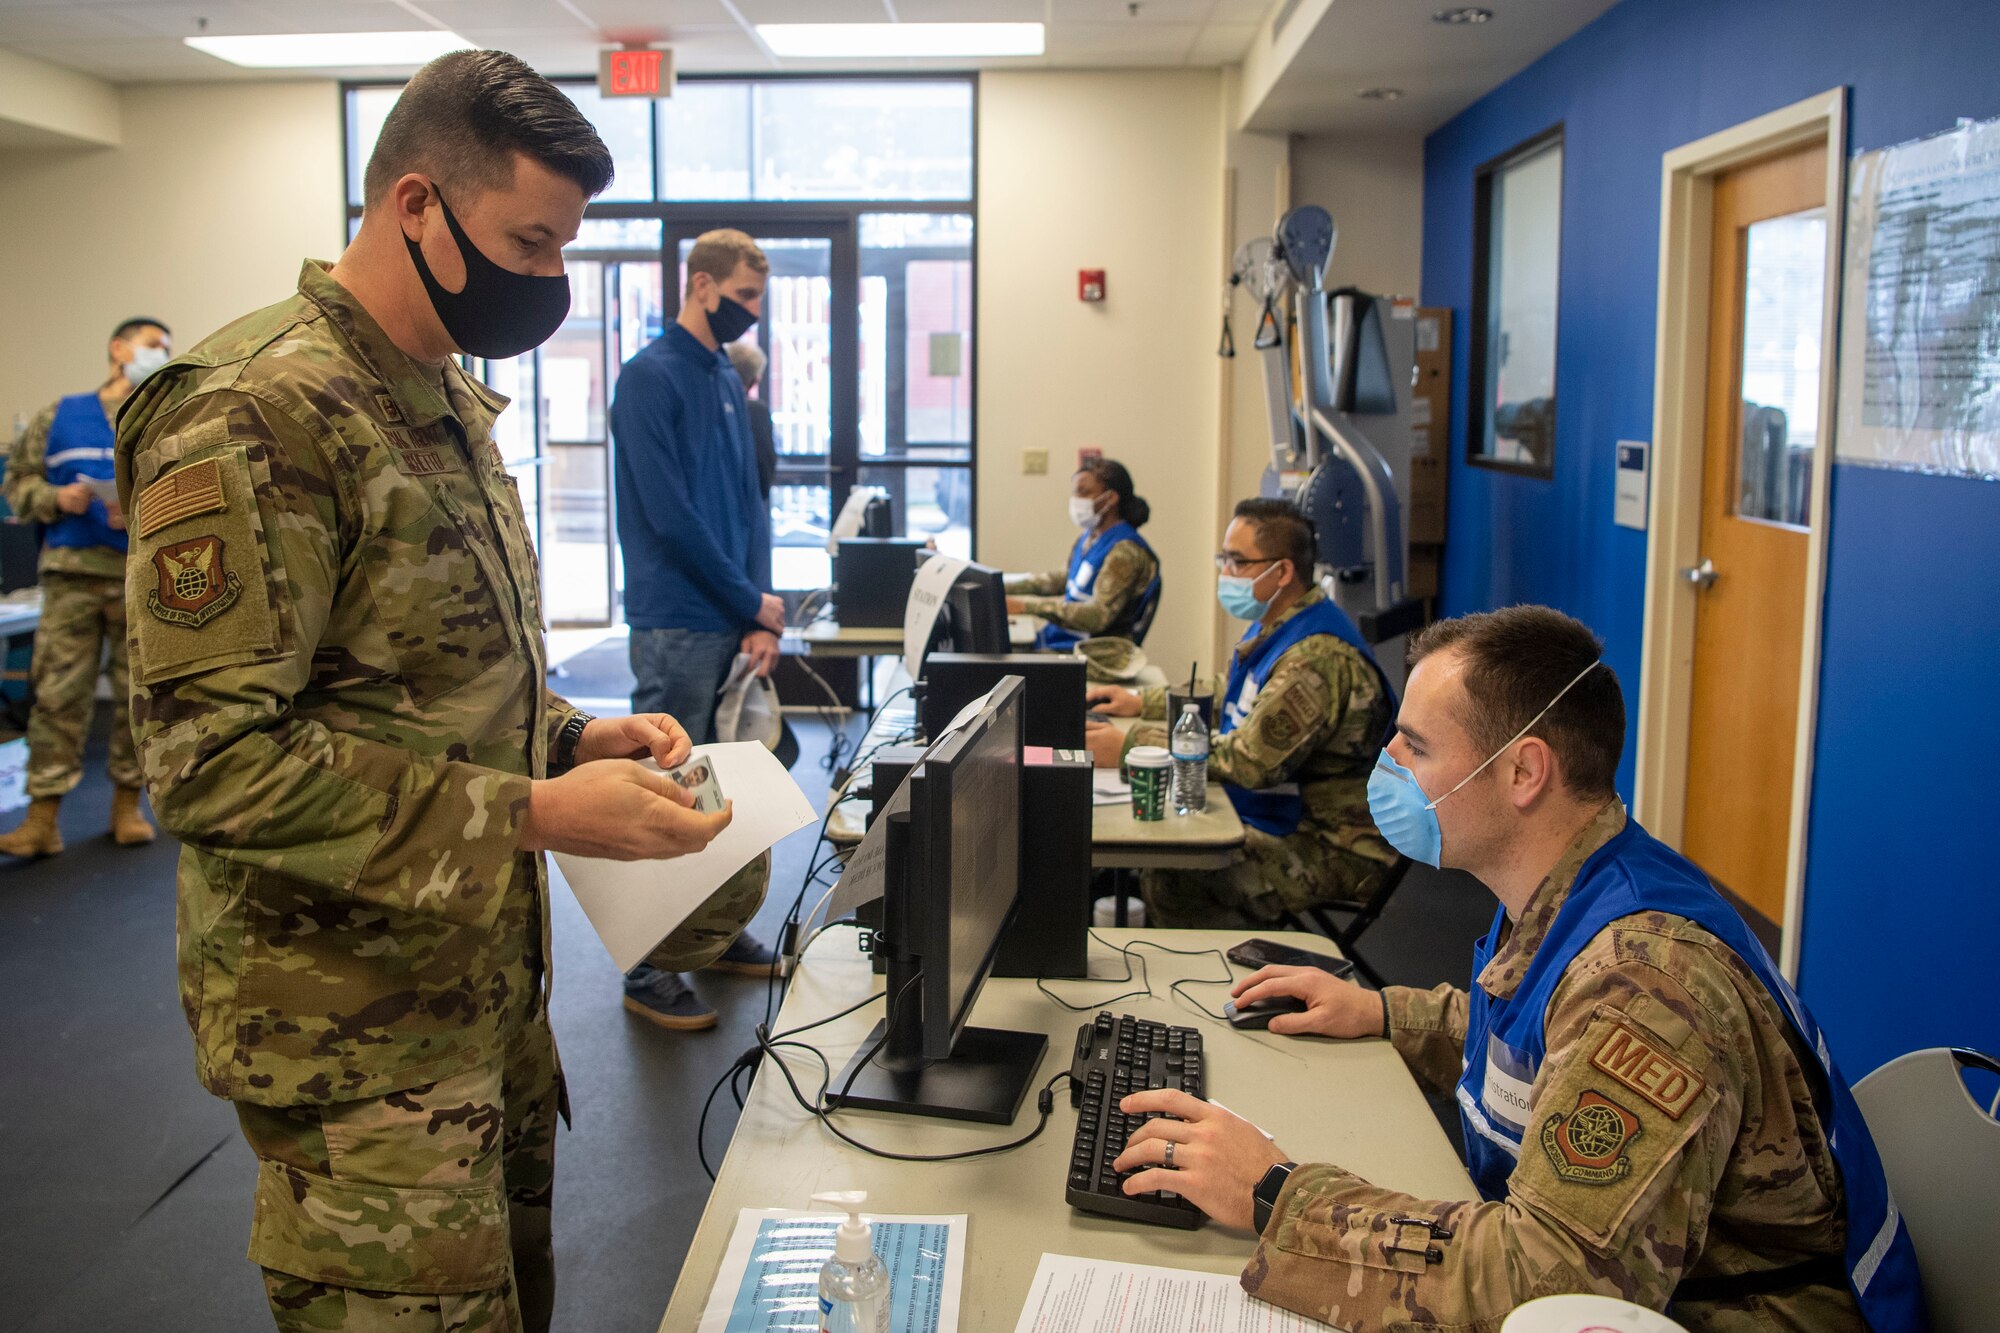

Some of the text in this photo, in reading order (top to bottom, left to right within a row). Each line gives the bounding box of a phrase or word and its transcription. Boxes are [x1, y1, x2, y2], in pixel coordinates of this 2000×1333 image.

[611, 51, 662, 94] EXIT
[169, 611, 178, 620] OF
[1601, 1033, 1688, 1103] MED
[1544, 1130, 1554, 1144] AIR
[1572, 1167, 1615, 1178] COMMAND
